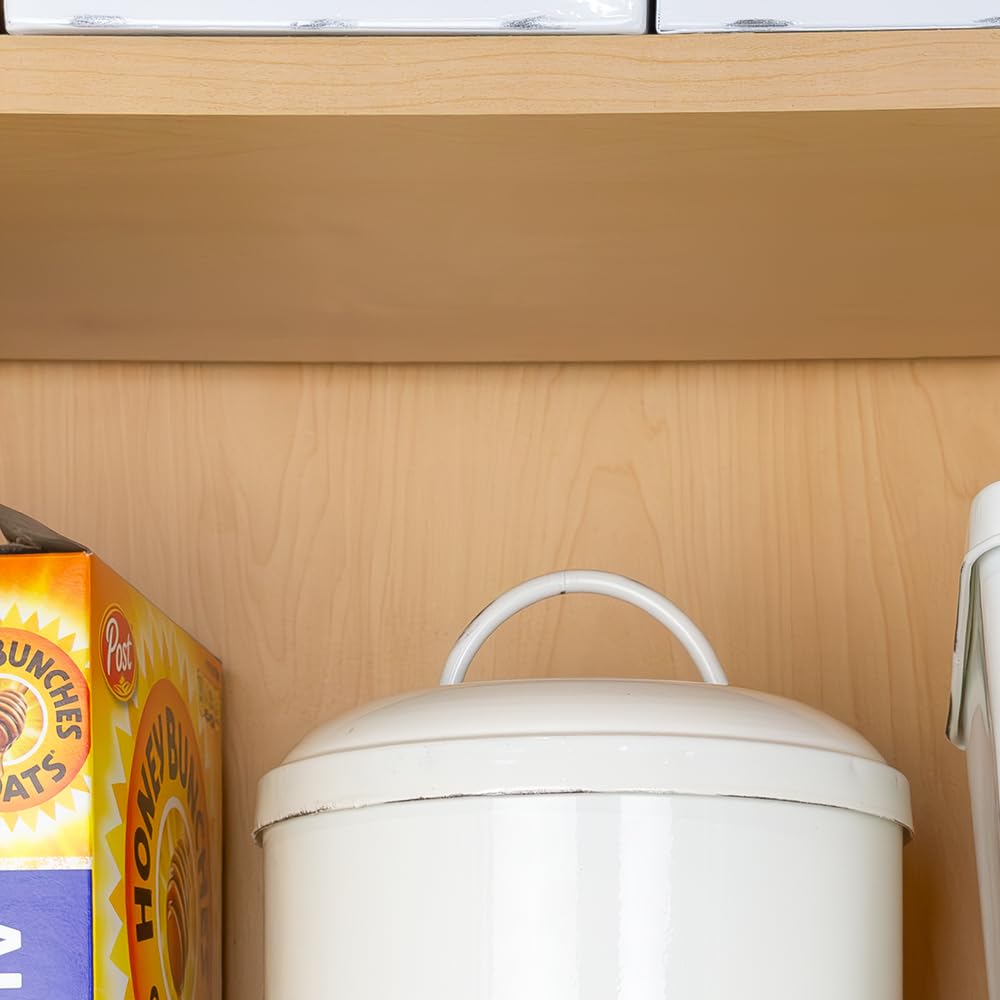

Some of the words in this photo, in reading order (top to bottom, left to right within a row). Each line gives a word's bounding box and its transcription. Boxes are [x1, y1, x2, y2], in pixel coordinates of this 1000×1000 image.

[106, 617, 132, 676] Post
[0, 755, 66, 802] ATS
[133, 712, 164, 942] HONEY
